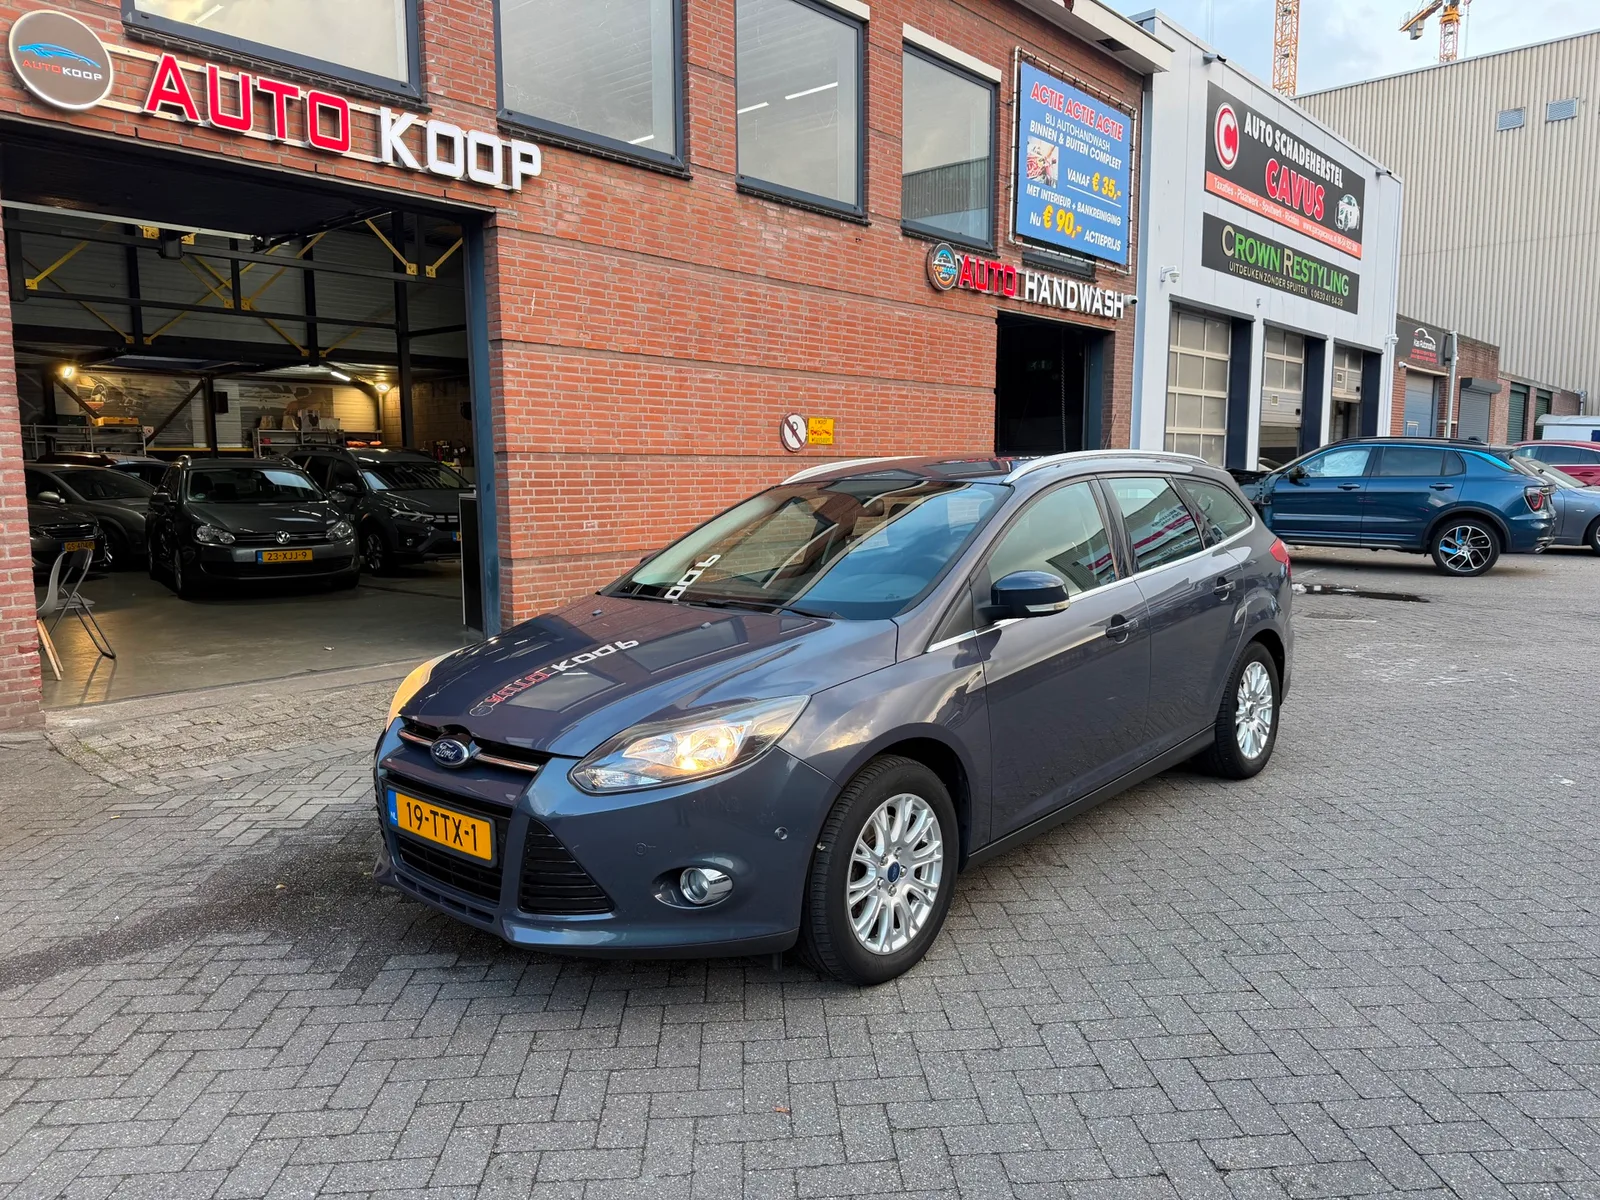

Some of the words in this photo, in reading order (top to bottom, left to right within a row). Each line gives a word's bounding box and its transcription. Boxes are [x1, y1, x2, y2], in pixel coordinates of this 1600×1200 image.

[145, 52, 351, 155] AUTO
[379, 106, 542, 191] KOOP
[1030, 81, 1064, 112] ACTIE
[1064, 98, 1095, 127] ACTIE
[1096, 114, 1123, 142] ACTIE
[1045, 113, 1056, 126] BIJ
[1057, 119, 1110, 152] AUTOHANDWASH
[1030, 120, 1057, 142] BINNEN
[1058, 133, 1064, 144] &
[1065, 136, 1089, 156] BUITEN
[1089, 146, 1122, 170] COMPLEET
[1244, 111, 1273, 148] AUTO
[1274, 129, 1343, 189] SCHADEHERSTEL
[1026, 184, 1040, 197] MET
[1040, 189, 1072, 209] INTERIEUR
[1071, 202, 1076, 210] +
[1077, 202, 1121, 226] BANKREINIGING
[1067, 168, 1090, 187] VANAF
[1092, 172, 1100, 192] €
[1265, 157, 1325, 221] CAVUS
[1043, 204, 1054, 229] €
[1084, 229, 1121, 252] ACTIEPRIJS
[1222, 224, 1281, 273] CROWN
[1283, 247, 1349, 297] RESTYLING
[1229, 261, 1264, 280] UITDEUKEN
[1263, 272, 1286, 288] ZONDER
[1286, 280, 1308, 295] SPUITEN
[958, 254, 1017, 298] AUTO
[1024, 270, 1124, 319] HANDWASH
[267, 551, 307, 561] 23-XJJ-9
[435, 741, 458, 760] Ford
[407, 801, 478, 852] 19-TTX-1
